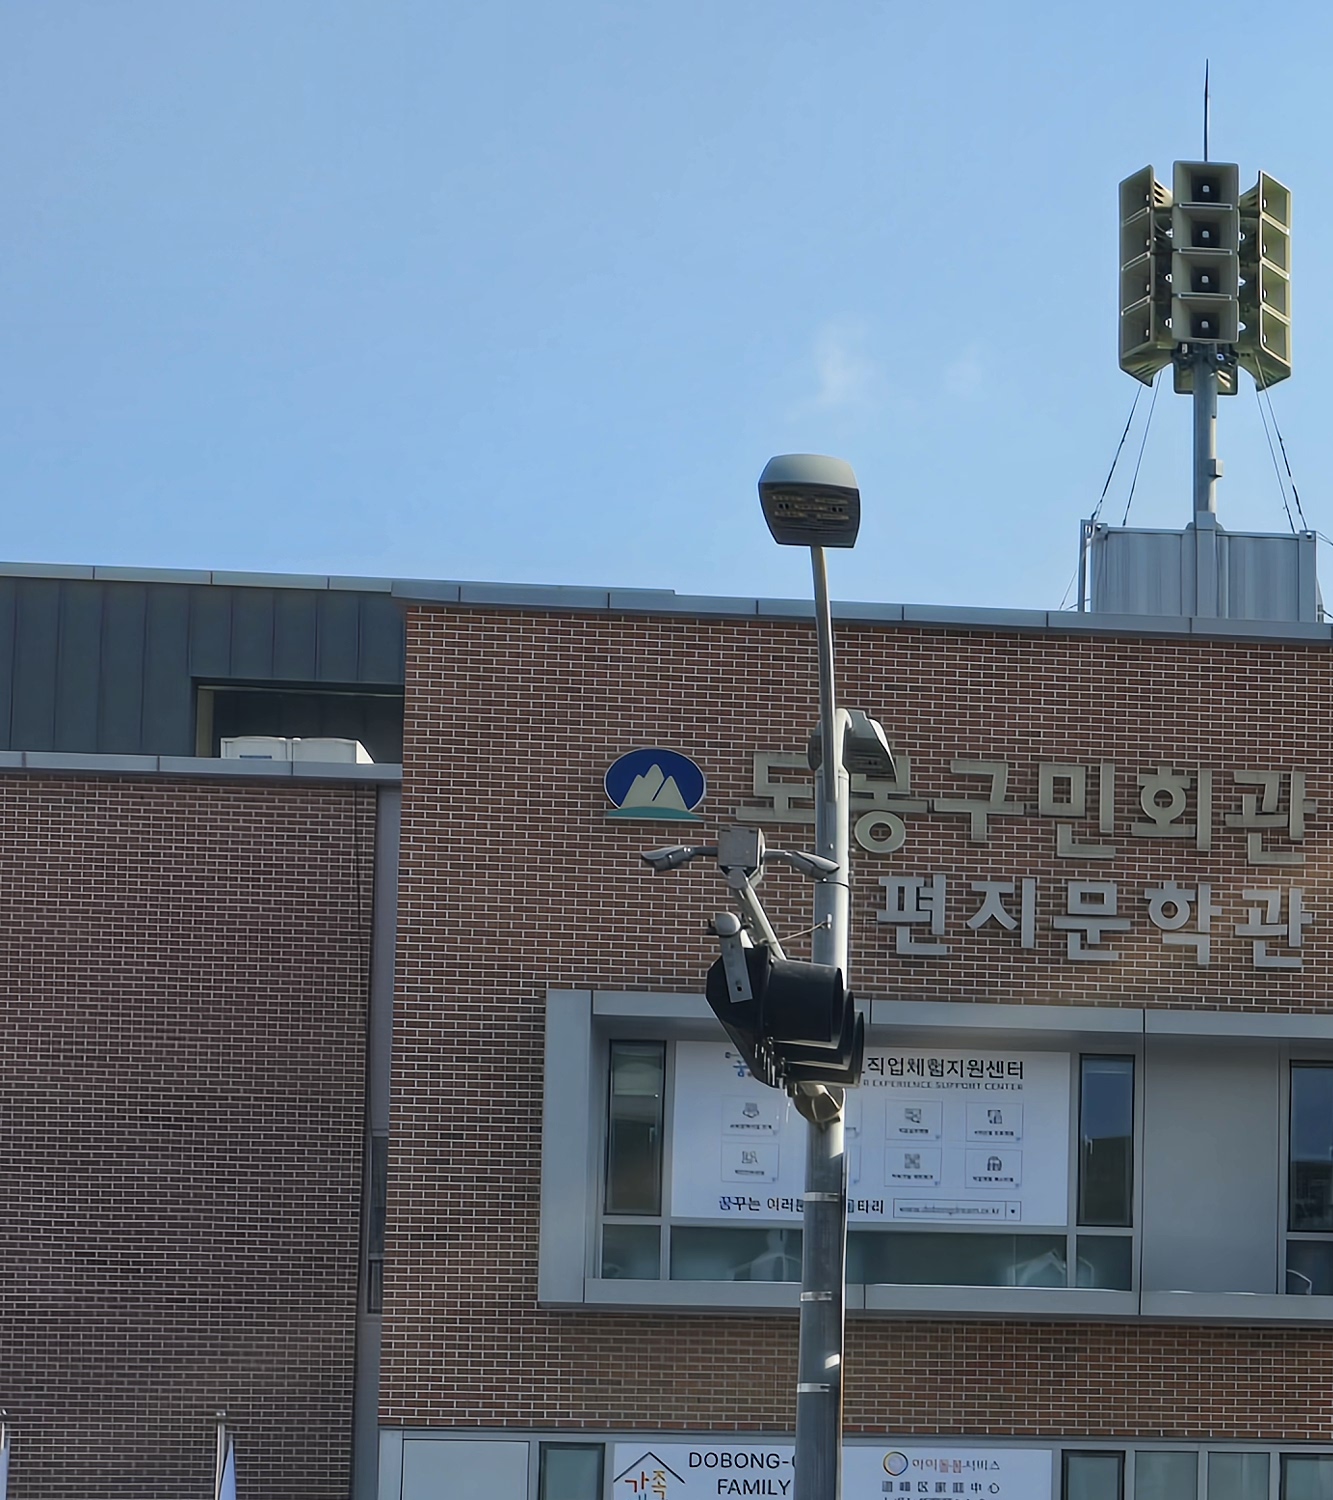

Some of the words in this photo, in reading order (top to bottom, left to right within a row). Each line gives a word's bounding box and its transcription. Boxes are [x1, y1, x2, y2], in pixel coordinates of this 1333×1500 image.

[735, 751, 1317, 865] 도봉구민회관
[877, 875, 1313, 968] 편지문학관
[862, 1056, 1024, 1080] 직업체험지원센터
[688, 1451, 796, 1470] DOBONG-
[624, 1470, 667, 1500] 가족
[717, 1478, 792, 1496] FAMILY
